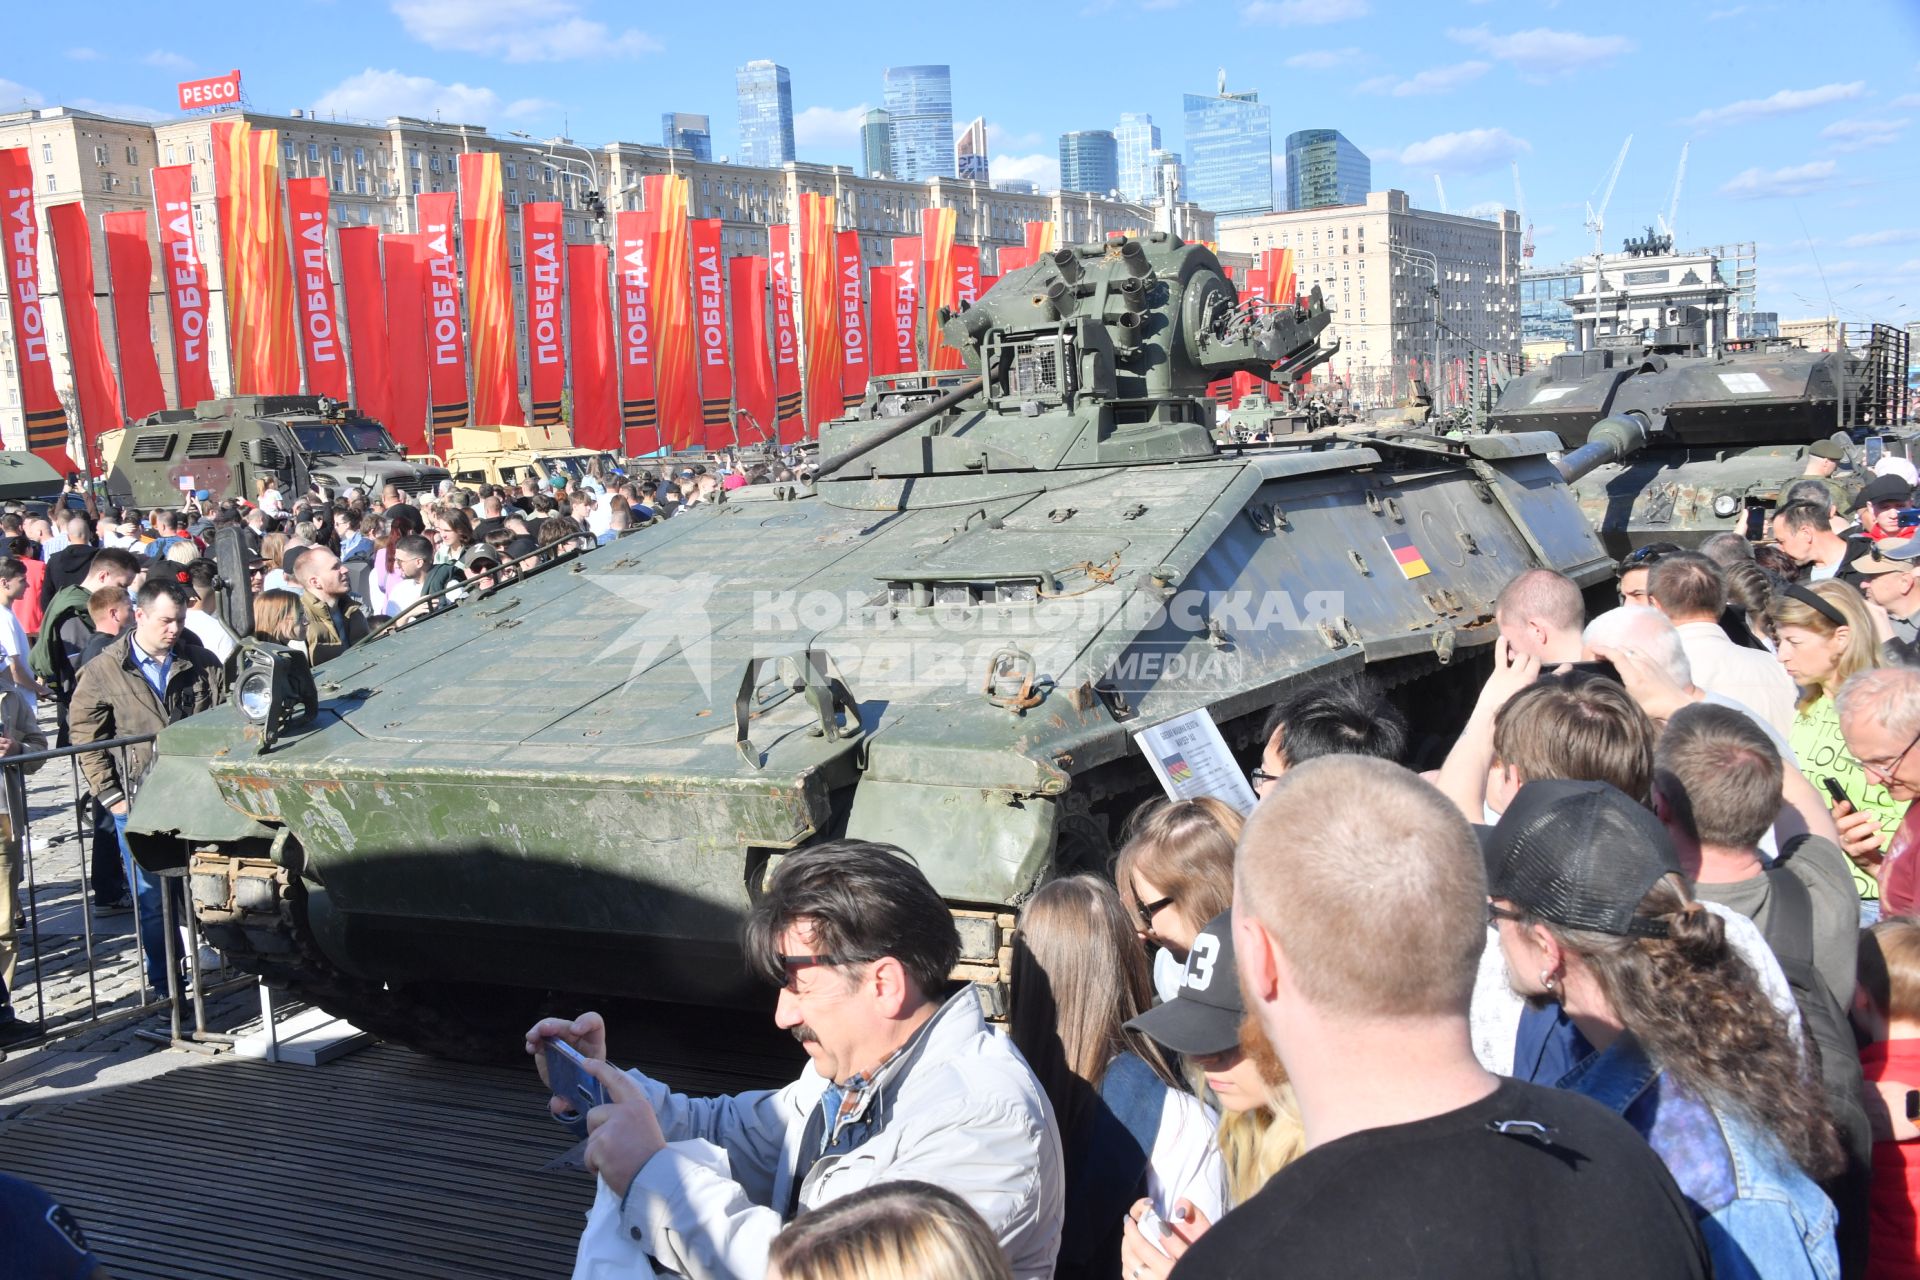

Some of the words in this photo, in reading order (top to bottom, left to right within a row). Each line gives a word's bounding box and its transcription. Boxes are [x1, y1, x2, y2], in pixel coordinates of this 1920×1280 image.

[183, 81, 235, 104] PESCO
[9, 187, 46, 362] ПОБЕДА!
[166, 202, 204, 362] ПОБЕДА!
[300, 211, 336, 362] ПОБЕДА!
[428, 224, 458, 365] ПОБЕДА!
[533, 232, 560, 365] ПОБЕДА!
[624, 239, 649, 365] ПОБЕДА!
[699, 246, 725, 366] ПОБЕДА!
[773, 251, 794, 364] ПОБЕДА!
[843, 255, 864, 365] ПОБЕДА!
[897, 260, 917, 364] ПОБЕДА!
